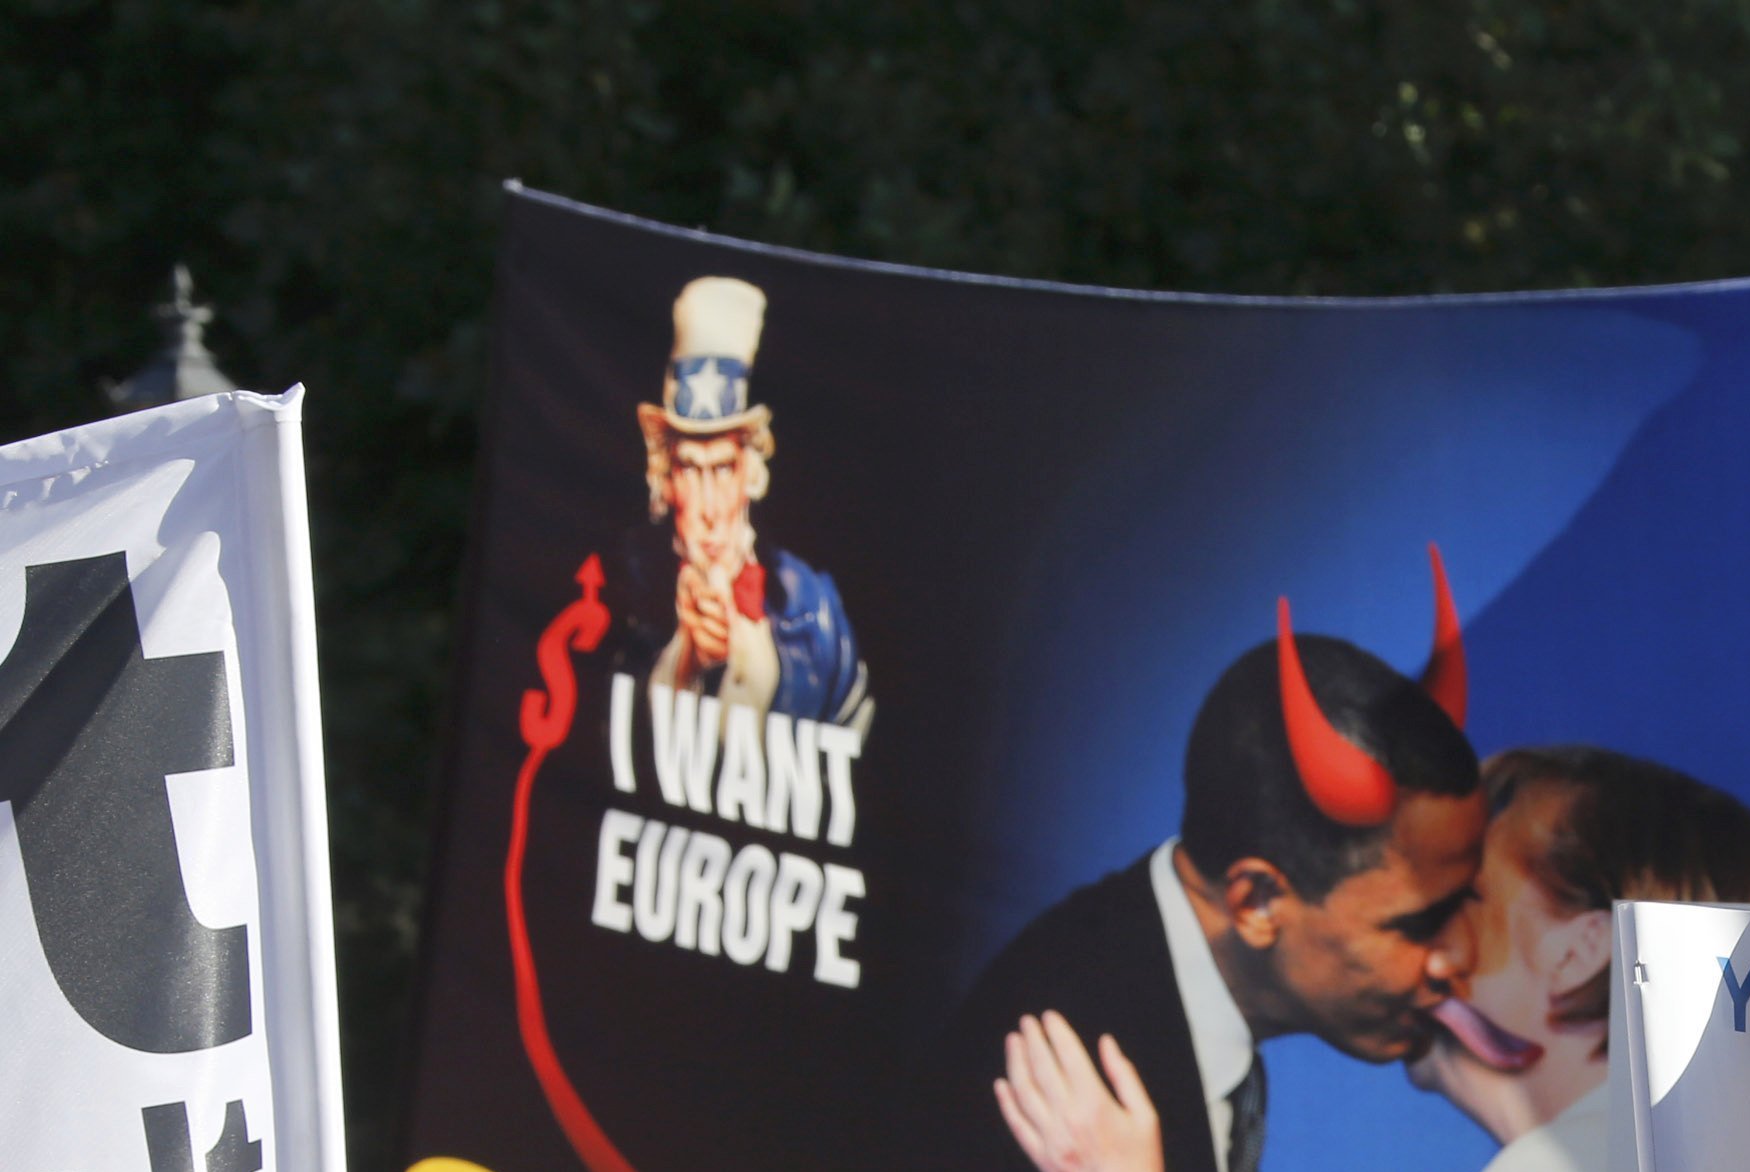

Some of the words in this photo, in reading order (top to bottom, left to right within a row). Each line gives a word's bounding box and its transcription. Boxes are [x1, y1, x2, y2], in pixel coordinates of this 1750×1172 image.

[610, 673, 637, 794] I
[650, 684, 862, 848] WANT
[591, 808, 866, 990] EUROPE
